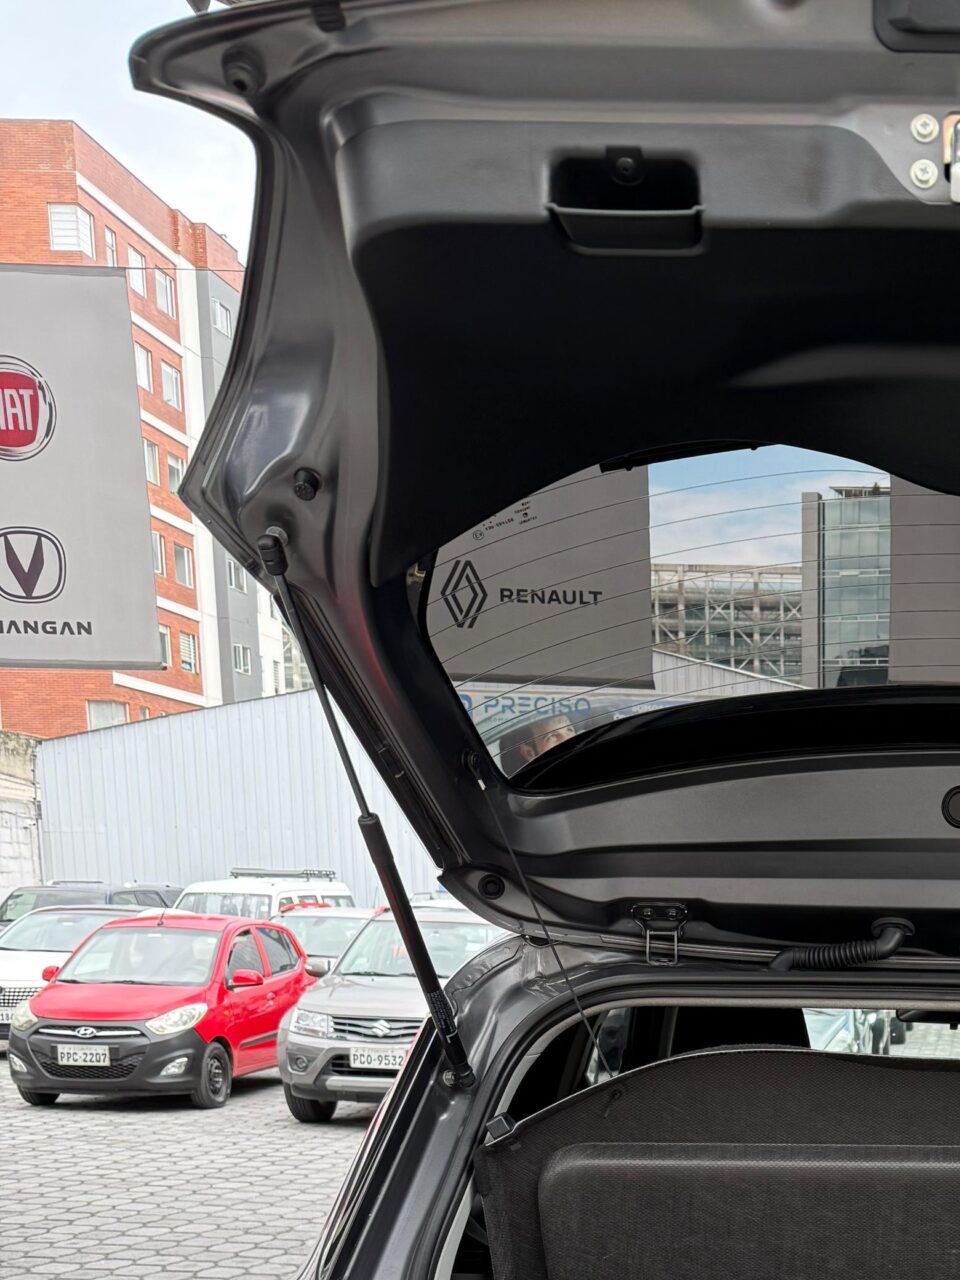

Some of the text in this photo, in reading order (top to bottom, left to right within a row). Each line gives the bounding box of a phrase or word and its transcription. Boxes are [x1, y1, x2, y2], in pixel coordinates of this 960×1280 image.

[499, 587, 603, 606] RENAULT
[0, 619, 93, 636] ANGAN
[483, 695, 592, 715] PRECISO
[60, 1051, 107, 1063] PPC-2207
